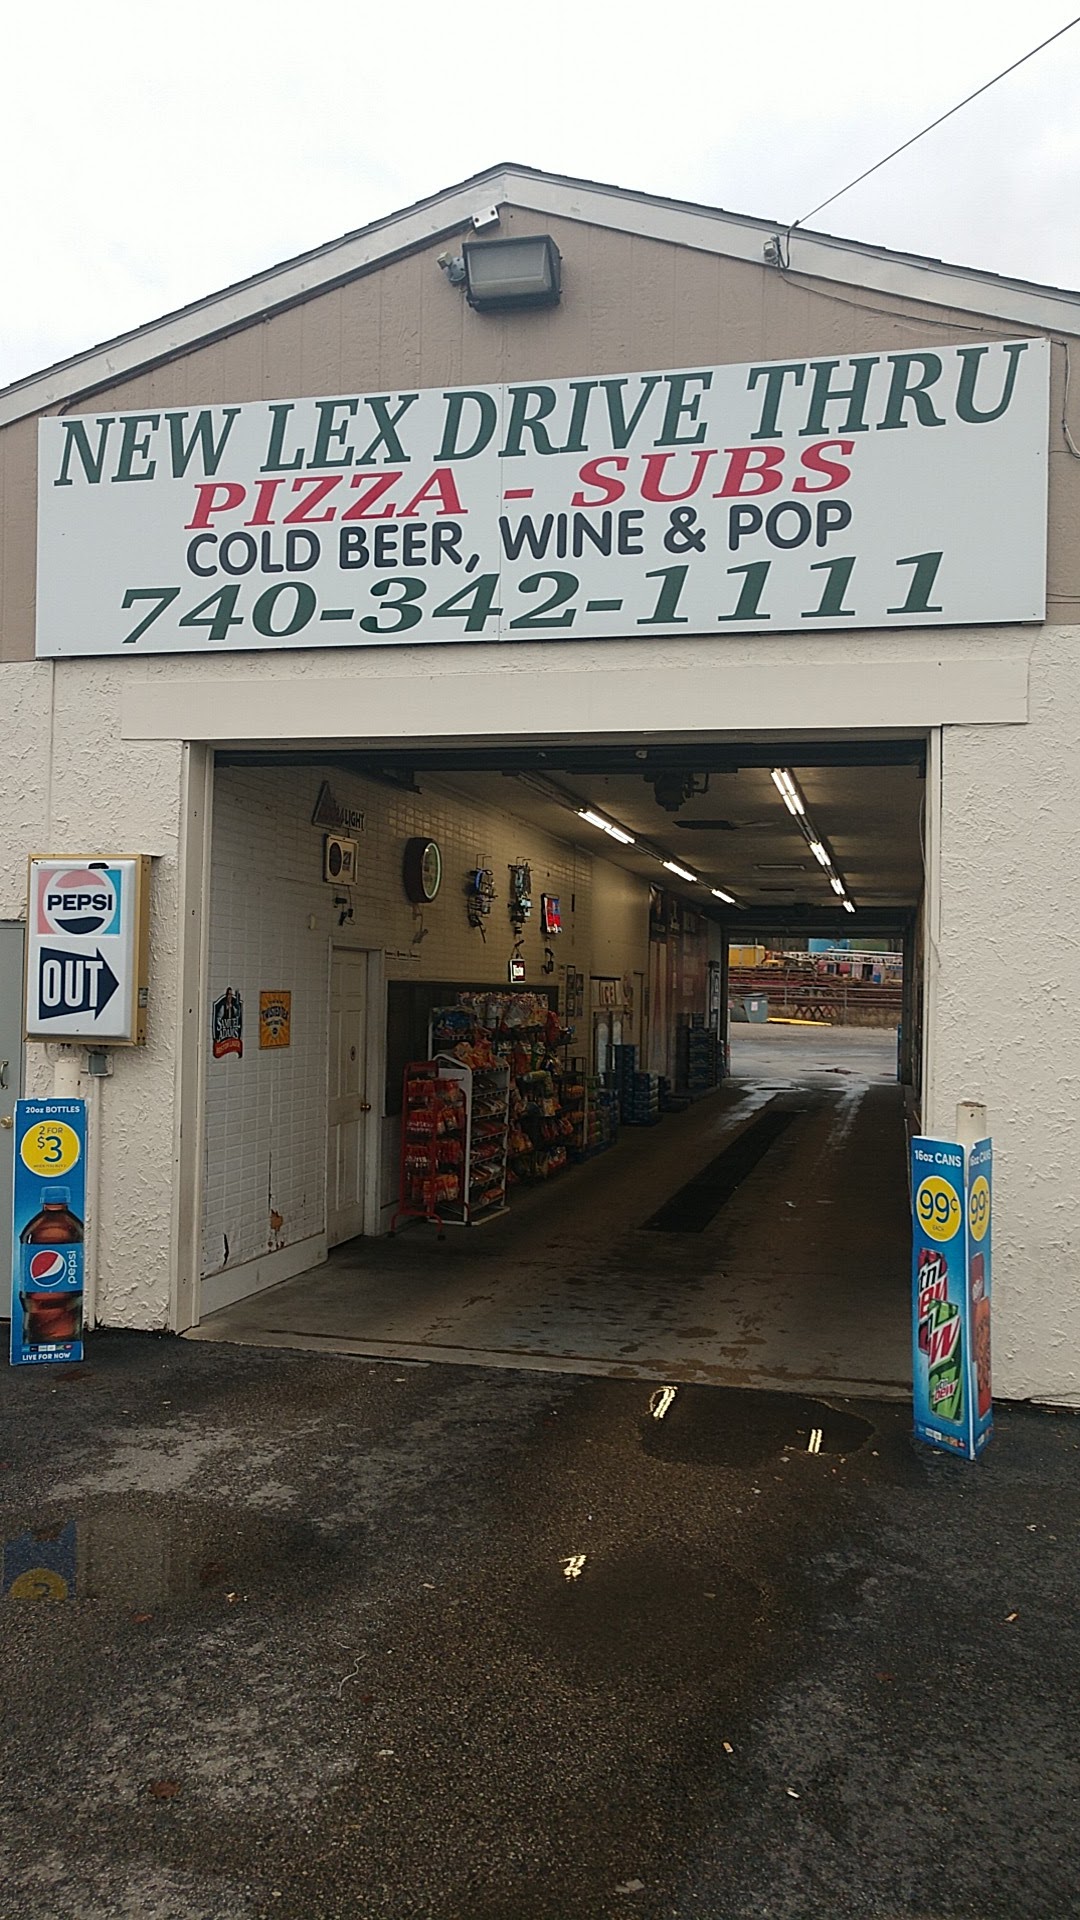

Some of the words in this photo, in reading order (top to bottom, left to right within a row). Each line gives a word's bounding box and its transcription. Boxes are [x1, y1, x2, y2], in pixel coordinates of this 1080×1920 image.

[53, 406, 242, 487] NEW
[260, 392, 419, 474] LEX
[433, 370, 713, 462] DRIVE
[747, 342, 1029, 440] THRU
[184, 467, 468, 530] PIZZA
[503, 487, 535, 500] -
[571, 439, 856, 507] SUBS
[186, 528, 321, 577] COLD
[339, 519, 480, 574] BEER,
[500, 508, 645, 561] WINE
[663, 505, 706, 554] &
[728, 499, 852, 551] POP
[120, 551, 944, 645] 740-342-1111
[344, 808, 365, 831] LIGHT
[47, 893, 113, 911] PEPSI
[42, 959, 104, 1008] OUT
[216, 1016, 241, 1031] SAMUEL
[217, 1027, 239, 1042] ADAMS
[39, 1126, 45, 1135] 2
[38, 1136, 62, 1162] $3
[914, 1150, 933, 1162] 16oz
[935, 1153, 961, 1167] CANS
[919, 1189, 958, 1224] 99¢
[67, 1251, 77, 1284] pepsi
